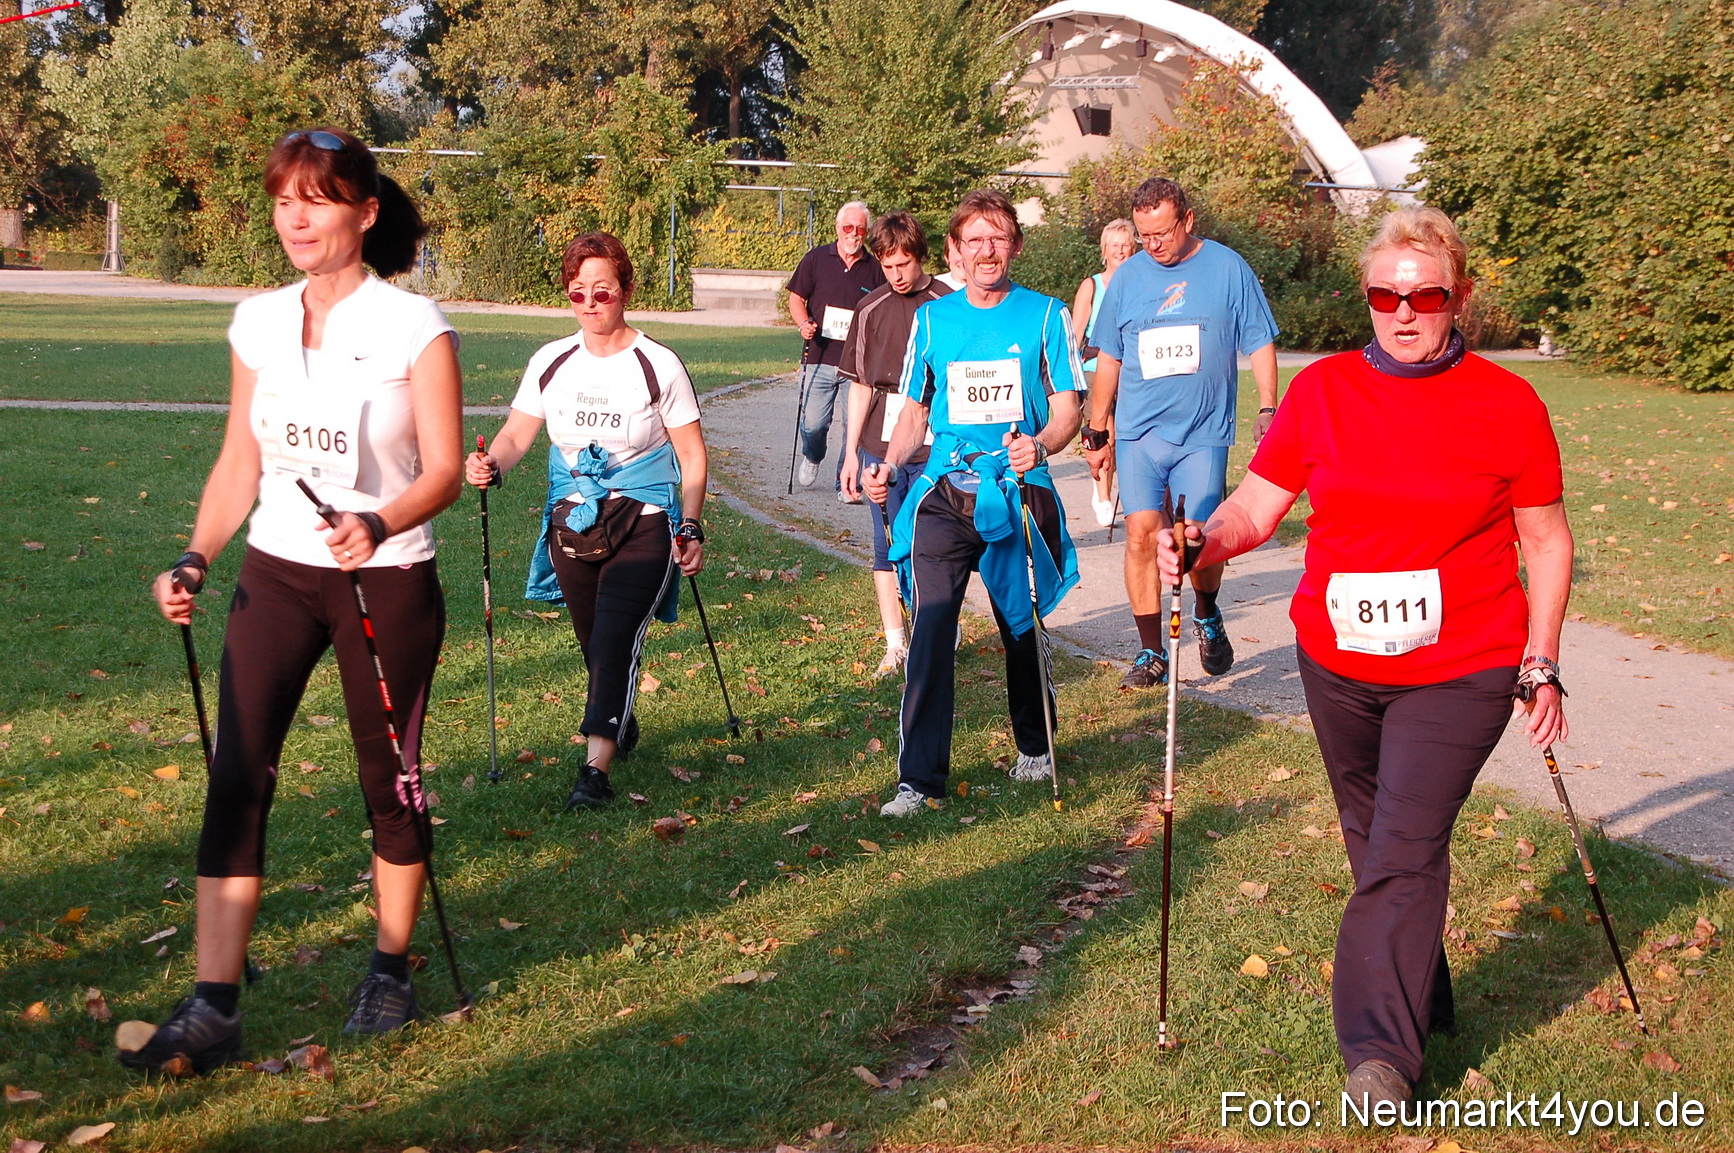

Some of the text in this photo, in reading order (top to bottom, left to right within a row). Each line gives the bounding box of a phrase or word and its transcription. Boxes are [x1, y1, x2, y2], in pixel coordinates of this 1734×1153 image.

[832, 319, 850, 331] 815
[1155, 344, 1194, 360] 8123
[965, 366, 997, 379] Günter
[576, 391, 609, 406] Regina
[967, 384, 1014, 403] 8077
[575, 410, 622, 429] 8078
[286, 422, 348, 455] 8106
[1331, 597, 1428, 624] N 8111
